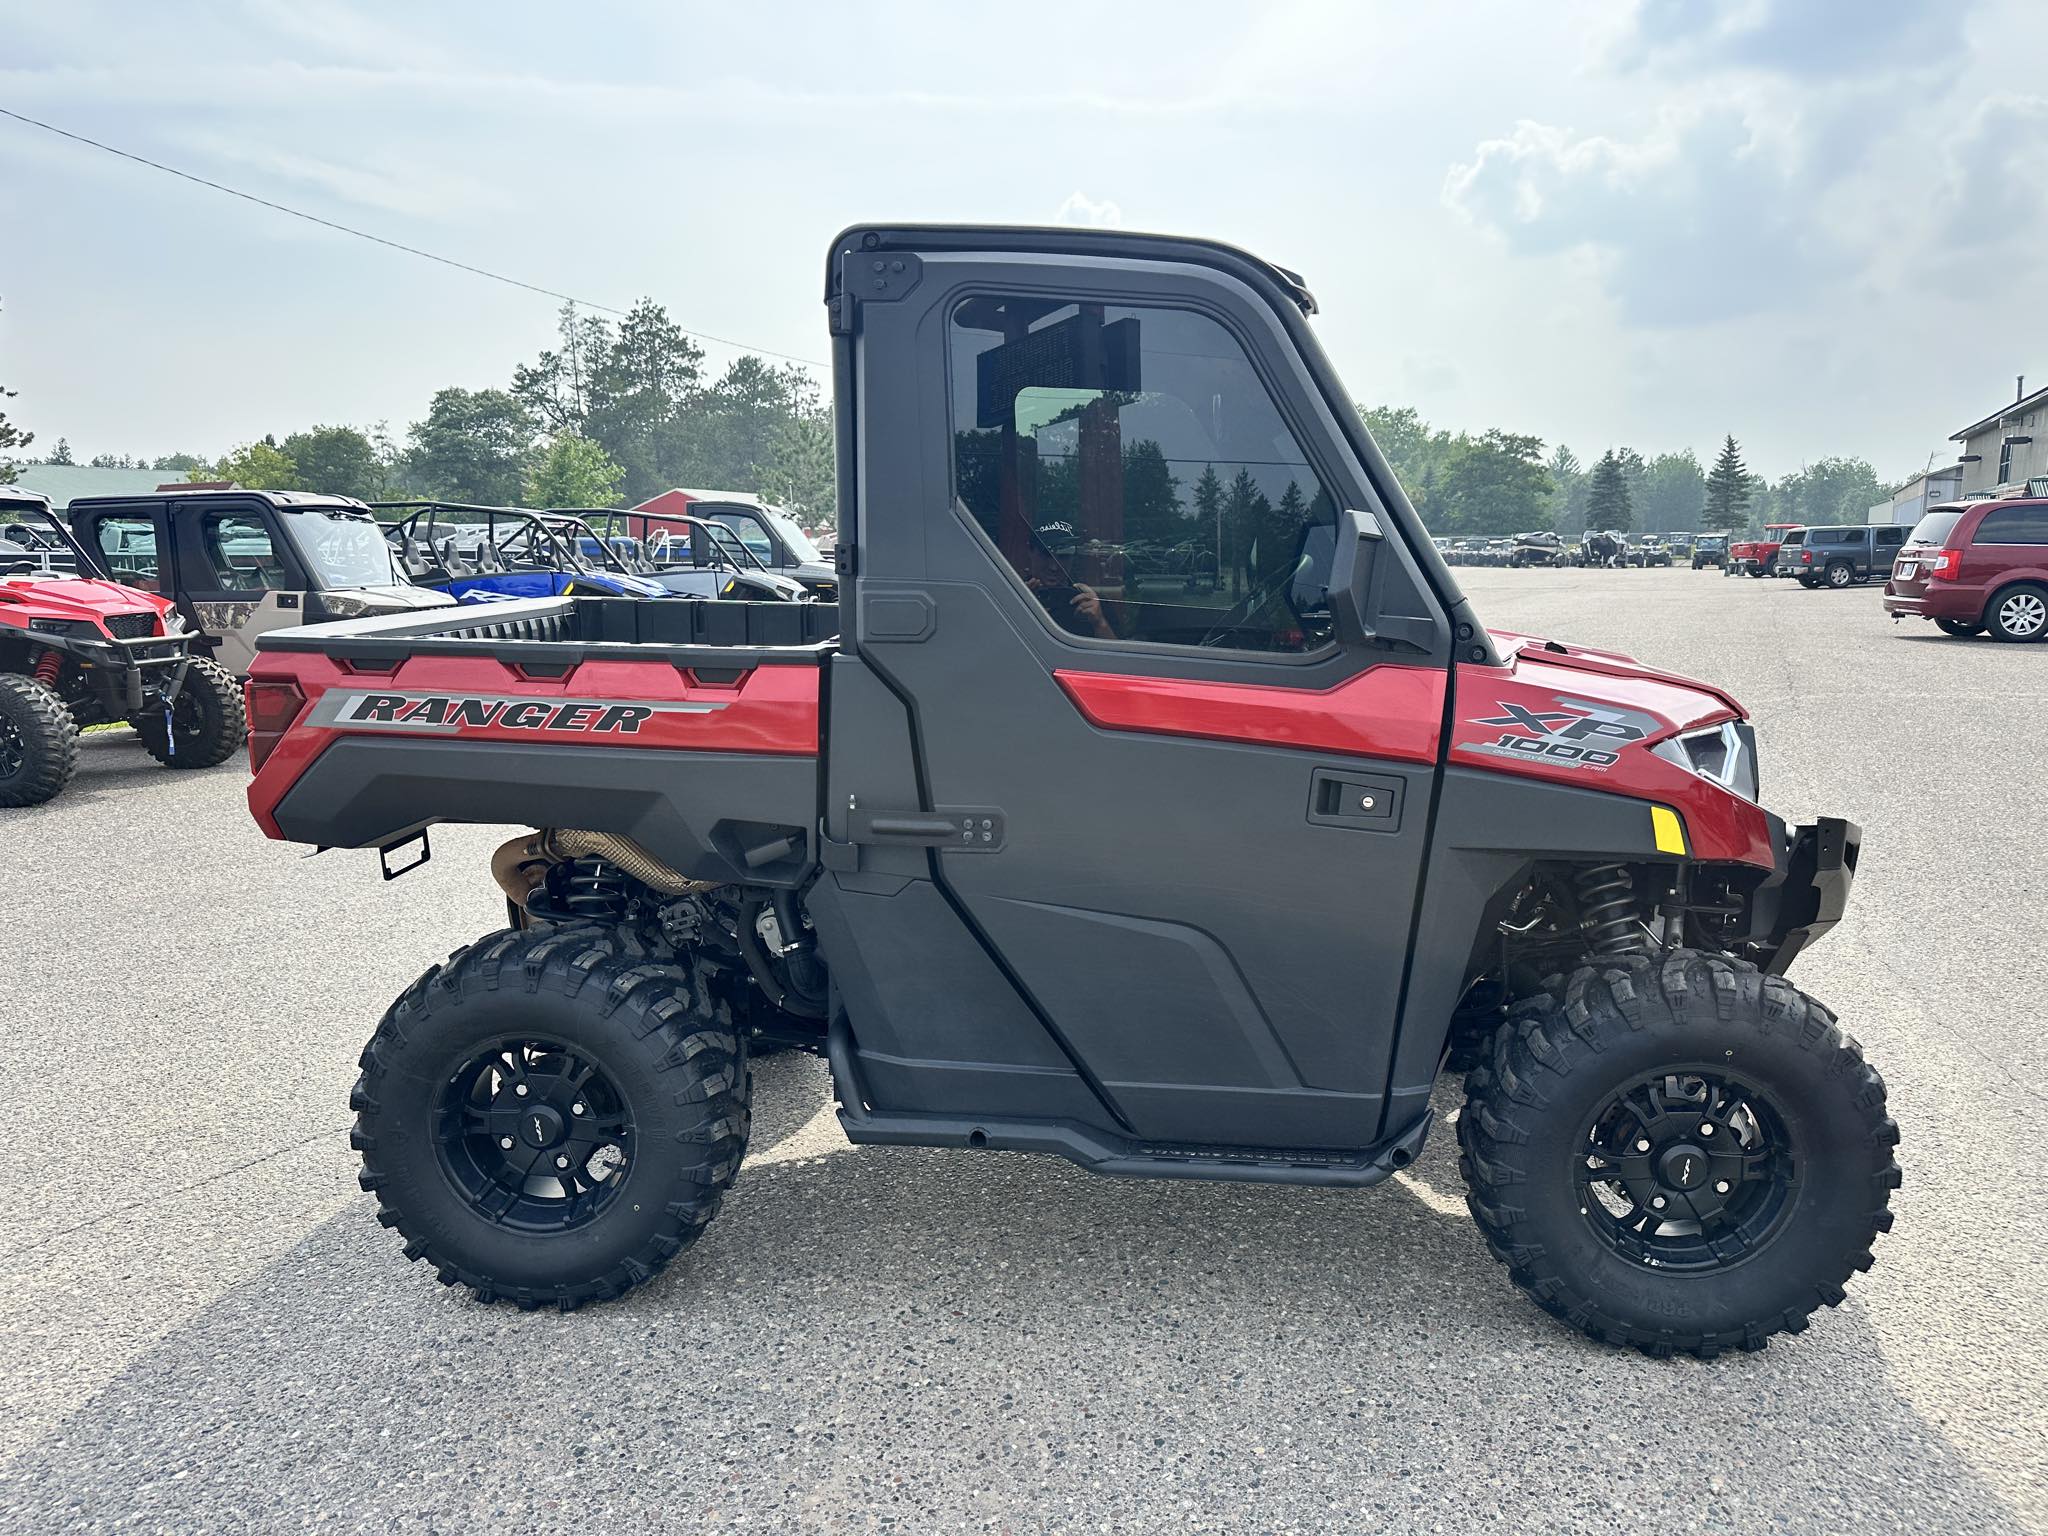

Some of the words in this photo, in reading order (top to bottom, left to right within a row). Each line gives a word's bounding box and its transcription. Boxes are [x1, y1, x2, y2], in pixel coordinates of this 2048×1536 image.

[348, 693, 653, 733] RANGER
[1464, 700, 1647, 742] XP
[1492, 748, 1521, 758] DUAL
[1523, 754, 1581, 769] OVERHEAD
[1583, 764, 1608, 773] CAM
[1495, 733, 1621, 767] 1000
